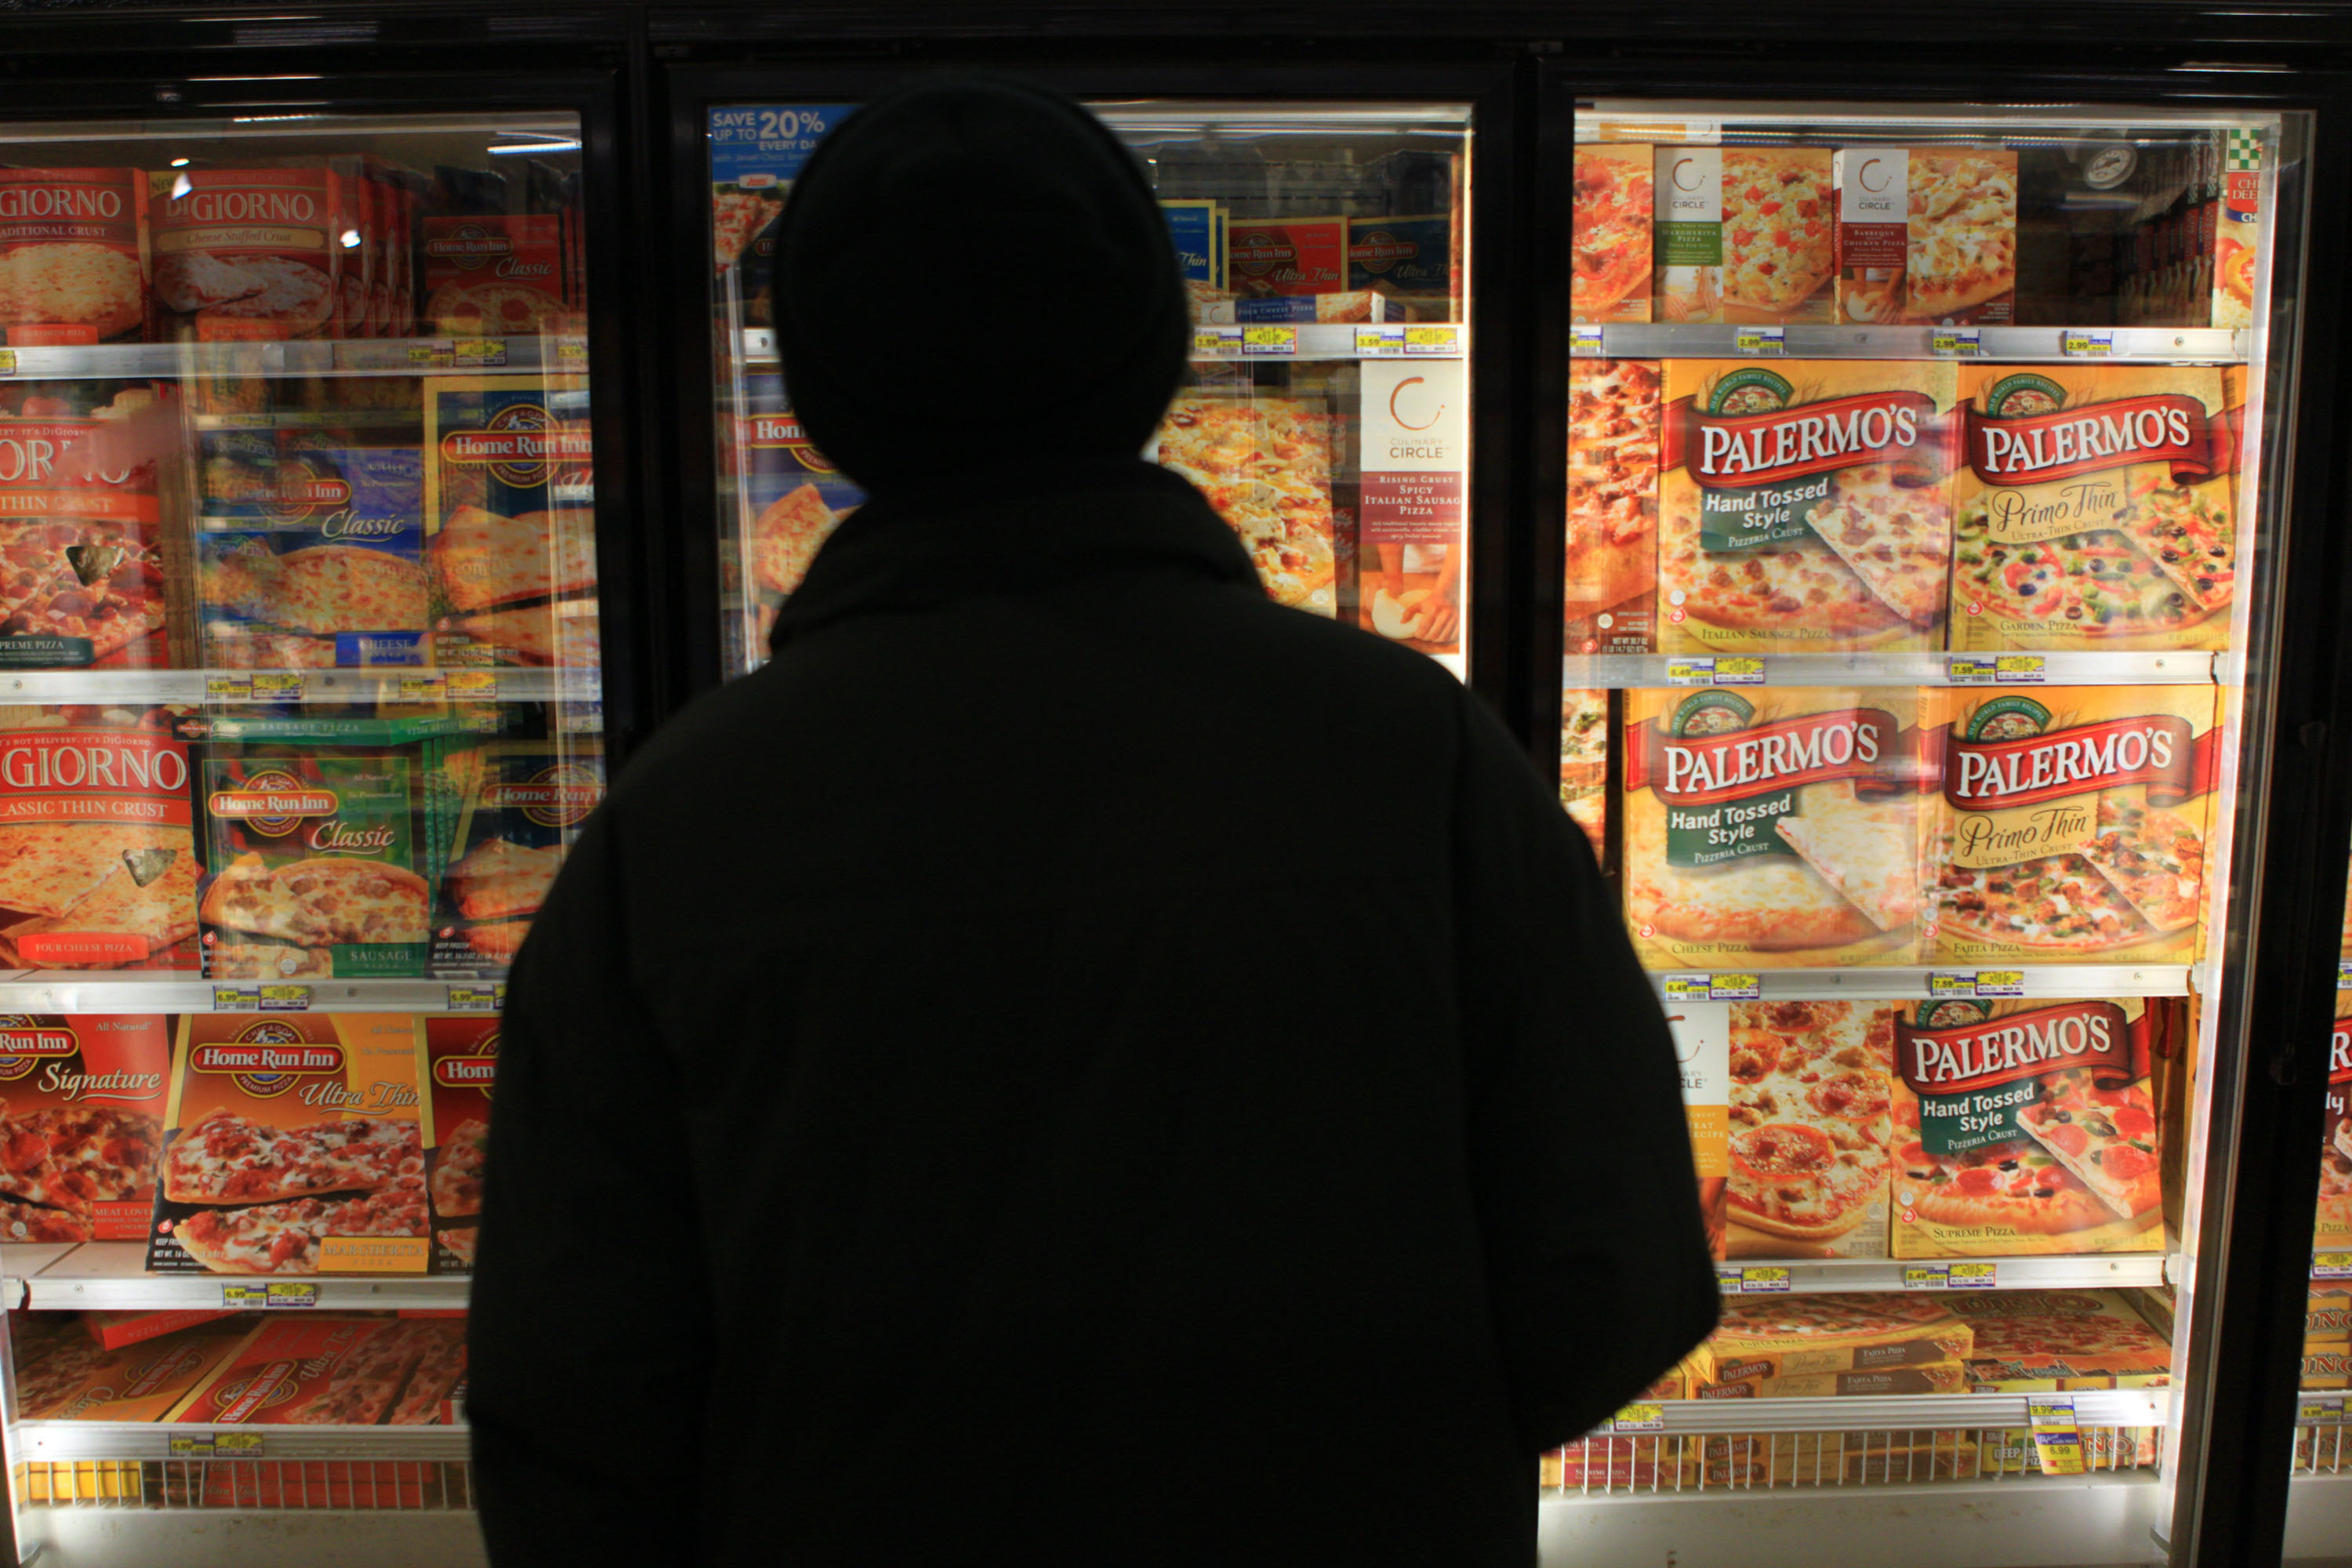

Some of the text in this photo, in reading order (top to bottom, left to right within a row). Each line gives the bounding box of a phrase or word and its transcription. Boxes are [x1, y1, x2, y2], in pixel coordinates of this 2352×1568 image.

[713, 111, 826, 140] SAVE 20%
[713, 128, 757, 141] UP TO
[759, 140, 797, 151] EVERY
[1672, 201, 1705, 209] CIRCLE
[70, 226, 107, 237] CRUST
[434, 241, 507, 254] Home Run Inn
[1254, 249, 1292, 260] Run Inn
[1179, 252, 1207, 267] Thin
[495, 257, 553, 278] Classic
[1272, 267, 1339, 284] Ultra Thin
[1197, 339, 1218, 347] 3.59
[1359, 338, 1380, 347] 3.59
[1739, 338, 1760, 347] 2.99
[1934, 340, 1955, 349] 2.99
[2068, 341, 2088, 350] 2.99
[1390, 437, 1443, 446] CULINARY
[1700, 404, 1917, 475] PALERMO'S
[1982, 405, 2190, 472] PALERMO'S
[455, 437, 514, 456] Home
[516, 437, 555, 458] Run
[1389, 447, 1443, 459] CIRCLE
[314, 485, 341, 499] Inn
[1399, 485, 1434, 495] SPICY
[1705, 477, 1828, 513] Hand Tossed
[1, 495, 48, 510] THIN
[1365, 495, 1412, 505] ITALIAN
[1992, 481, 2117, 532] Primo Thin
[1399, 506, 1433, 515] PIZZA
[321, 508, 406, 538] Classic
[1743, 507, 1791, 530] Style
[1728, 526, 1805, 548] PIZZERIA CRUST
[2012, 517, 2105, 542] ULTRA-THIN CRUST
[2000, 619, 2078, 632] GARDEN PIZZA
[1702, 628, 1829, 640] ITALIAN SAUSAGE PIZZA
[35, 641, 64, 650] PIZZA
[1953, 666, 1973, 674] 7.59
[1664, 720, 1879, 793] PALERMO'S
[1956, 726, 2173, 797] PALERMO'S
[2, 745, 187, 789] GIORNO
[495, 787, 550, 802] Home
[59, 800, 169, 818] THIN CRUST
[220, 796, 329, 812] Home Run Inn
[1671, 793, 1791, 829] Hand Tossed
[311, 820, 395, 851] Classic
[1708, 822, 1755, 846] Style
[1960, 805, 2088, 858] Primo Thin
[1694, 841, 1769, 864] PIZZERIA CRUST
[1976, 843, 2073, 866] ULTRA-THIN CRUST
[36, 943, 132, 953] FOUR CHEESE PIZZA
[1671, 942, 1751, 954] CHEESE PIZZA
[1954, 942, 2020, 953] FAJITA PIZZA
[350, 951, 412, 962] SAUSAGE
[1934, 980, 1954, 989] 7.59
[217, 993, 237, 1002] 6.99
[96, 1022, 110, 1031] All
[0, 1034, 68, 1051] Run Inn
[1911, 1012, 2111, 1083] PALERMO'S
[203, 1049, 335, 1069] Home Run Inn
[38, 1062, 162, 1102] Signature
[240, 1075, 294, 1093] PREMIUM PIZZA
[299, 1080, 419, 1107] Ultra Thin
[1923, 1082, 2035, 1118] Hand Tossed
[1960, 1112, 2003, 1134] Style
[1947, 1128, 2017, 1152] PIZZERIA CRUST
[1933, 1226, 2016, 1239] SUPREME PIZZA
[2321, 1223, 2350, 1233] PIZZA
[324, 1244, 423, 1257] MARGHERITA
[225, 1288, 245, 1298] 6.99
[1722, 1362, 1768, 1381] PALERMO'S
[1887, 1346, 1906, 1356] PIZZA
[1701, 1385, 1748, 1400] PALERMO'S
[1872, 1374, 1892, 1384] PIZZA
[220, 1396, 259, 1421] Home
[2031, 1406, 2053, 1415] 9.99
[2049, 1446, 2071, 1454] 6.99
